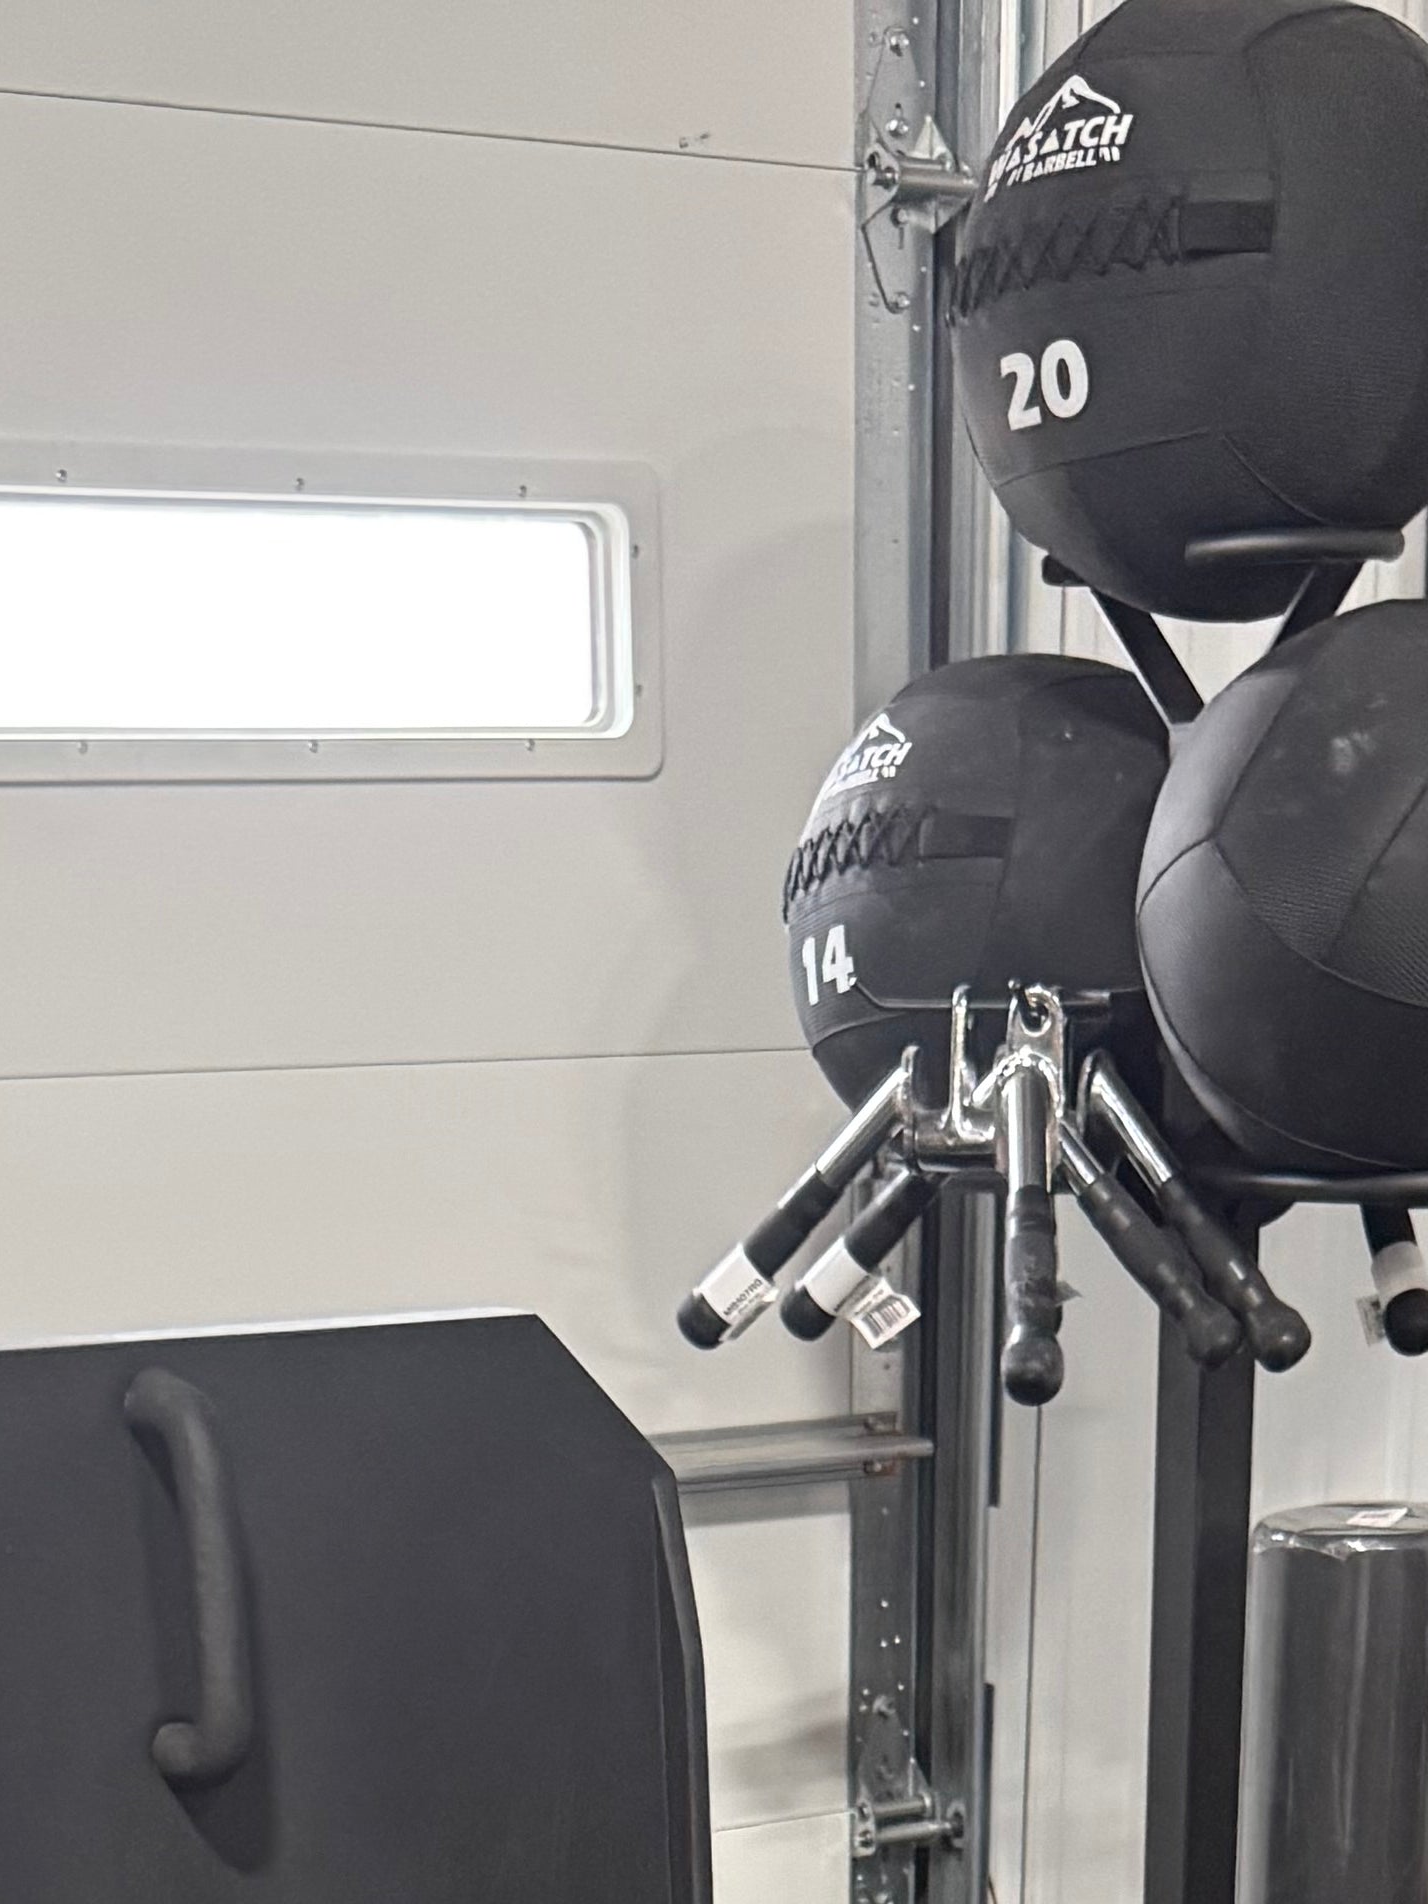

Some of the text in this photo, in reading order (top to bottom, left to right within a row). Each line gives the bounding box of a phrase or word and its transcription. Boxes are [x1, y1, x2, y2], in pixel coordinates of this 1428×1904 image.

[1022, 147, 1097, 183] BARBELL
[999, 339, 1089, 431] 20
[802, 924, 855, 1006] 14
